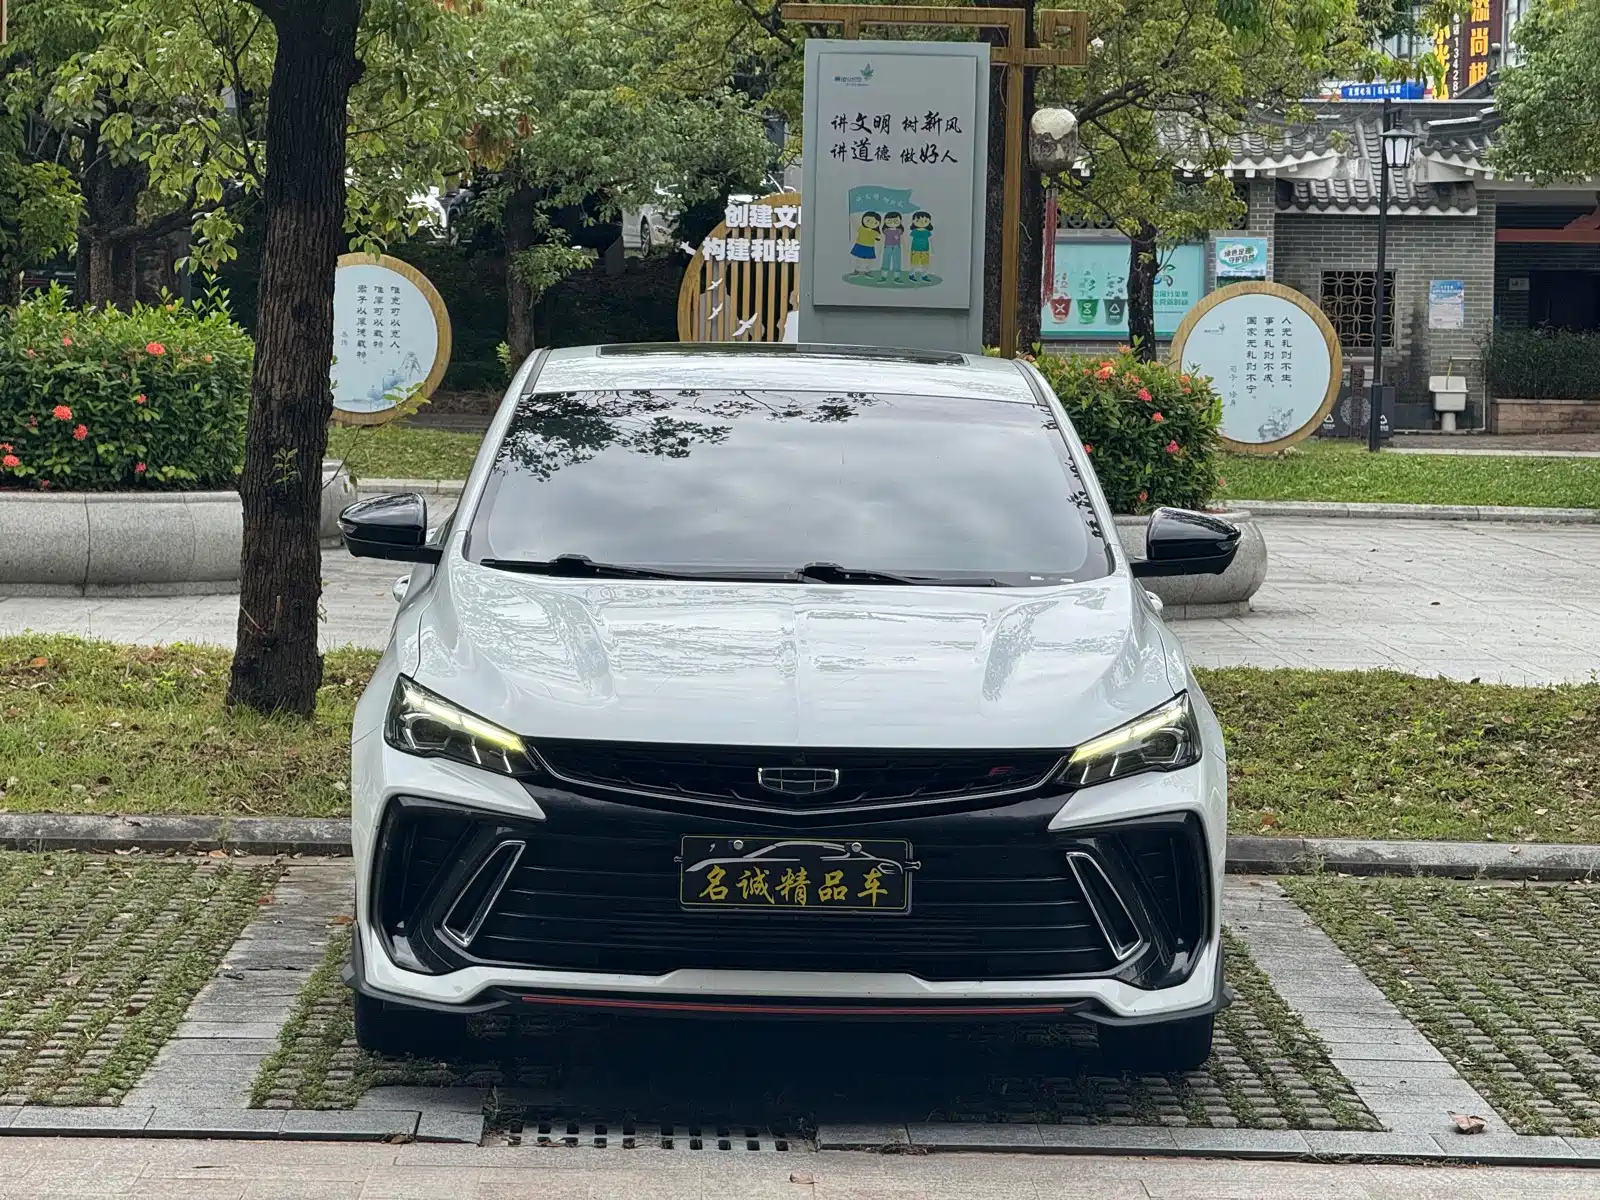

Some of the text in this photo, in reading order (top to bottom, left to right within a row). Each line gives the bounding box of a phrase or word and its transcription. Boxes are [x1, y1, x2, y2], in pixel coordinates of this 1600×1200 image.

[830, 110, 963, 137] 讲文明 树新风
[830, 137, 959, 164] 讲道德 做好人
[724, 204, 801, 229] 创建文
[702, 237, 800, 263] 构建和谐
[699, 864, 888, 907] 名诚精品车
